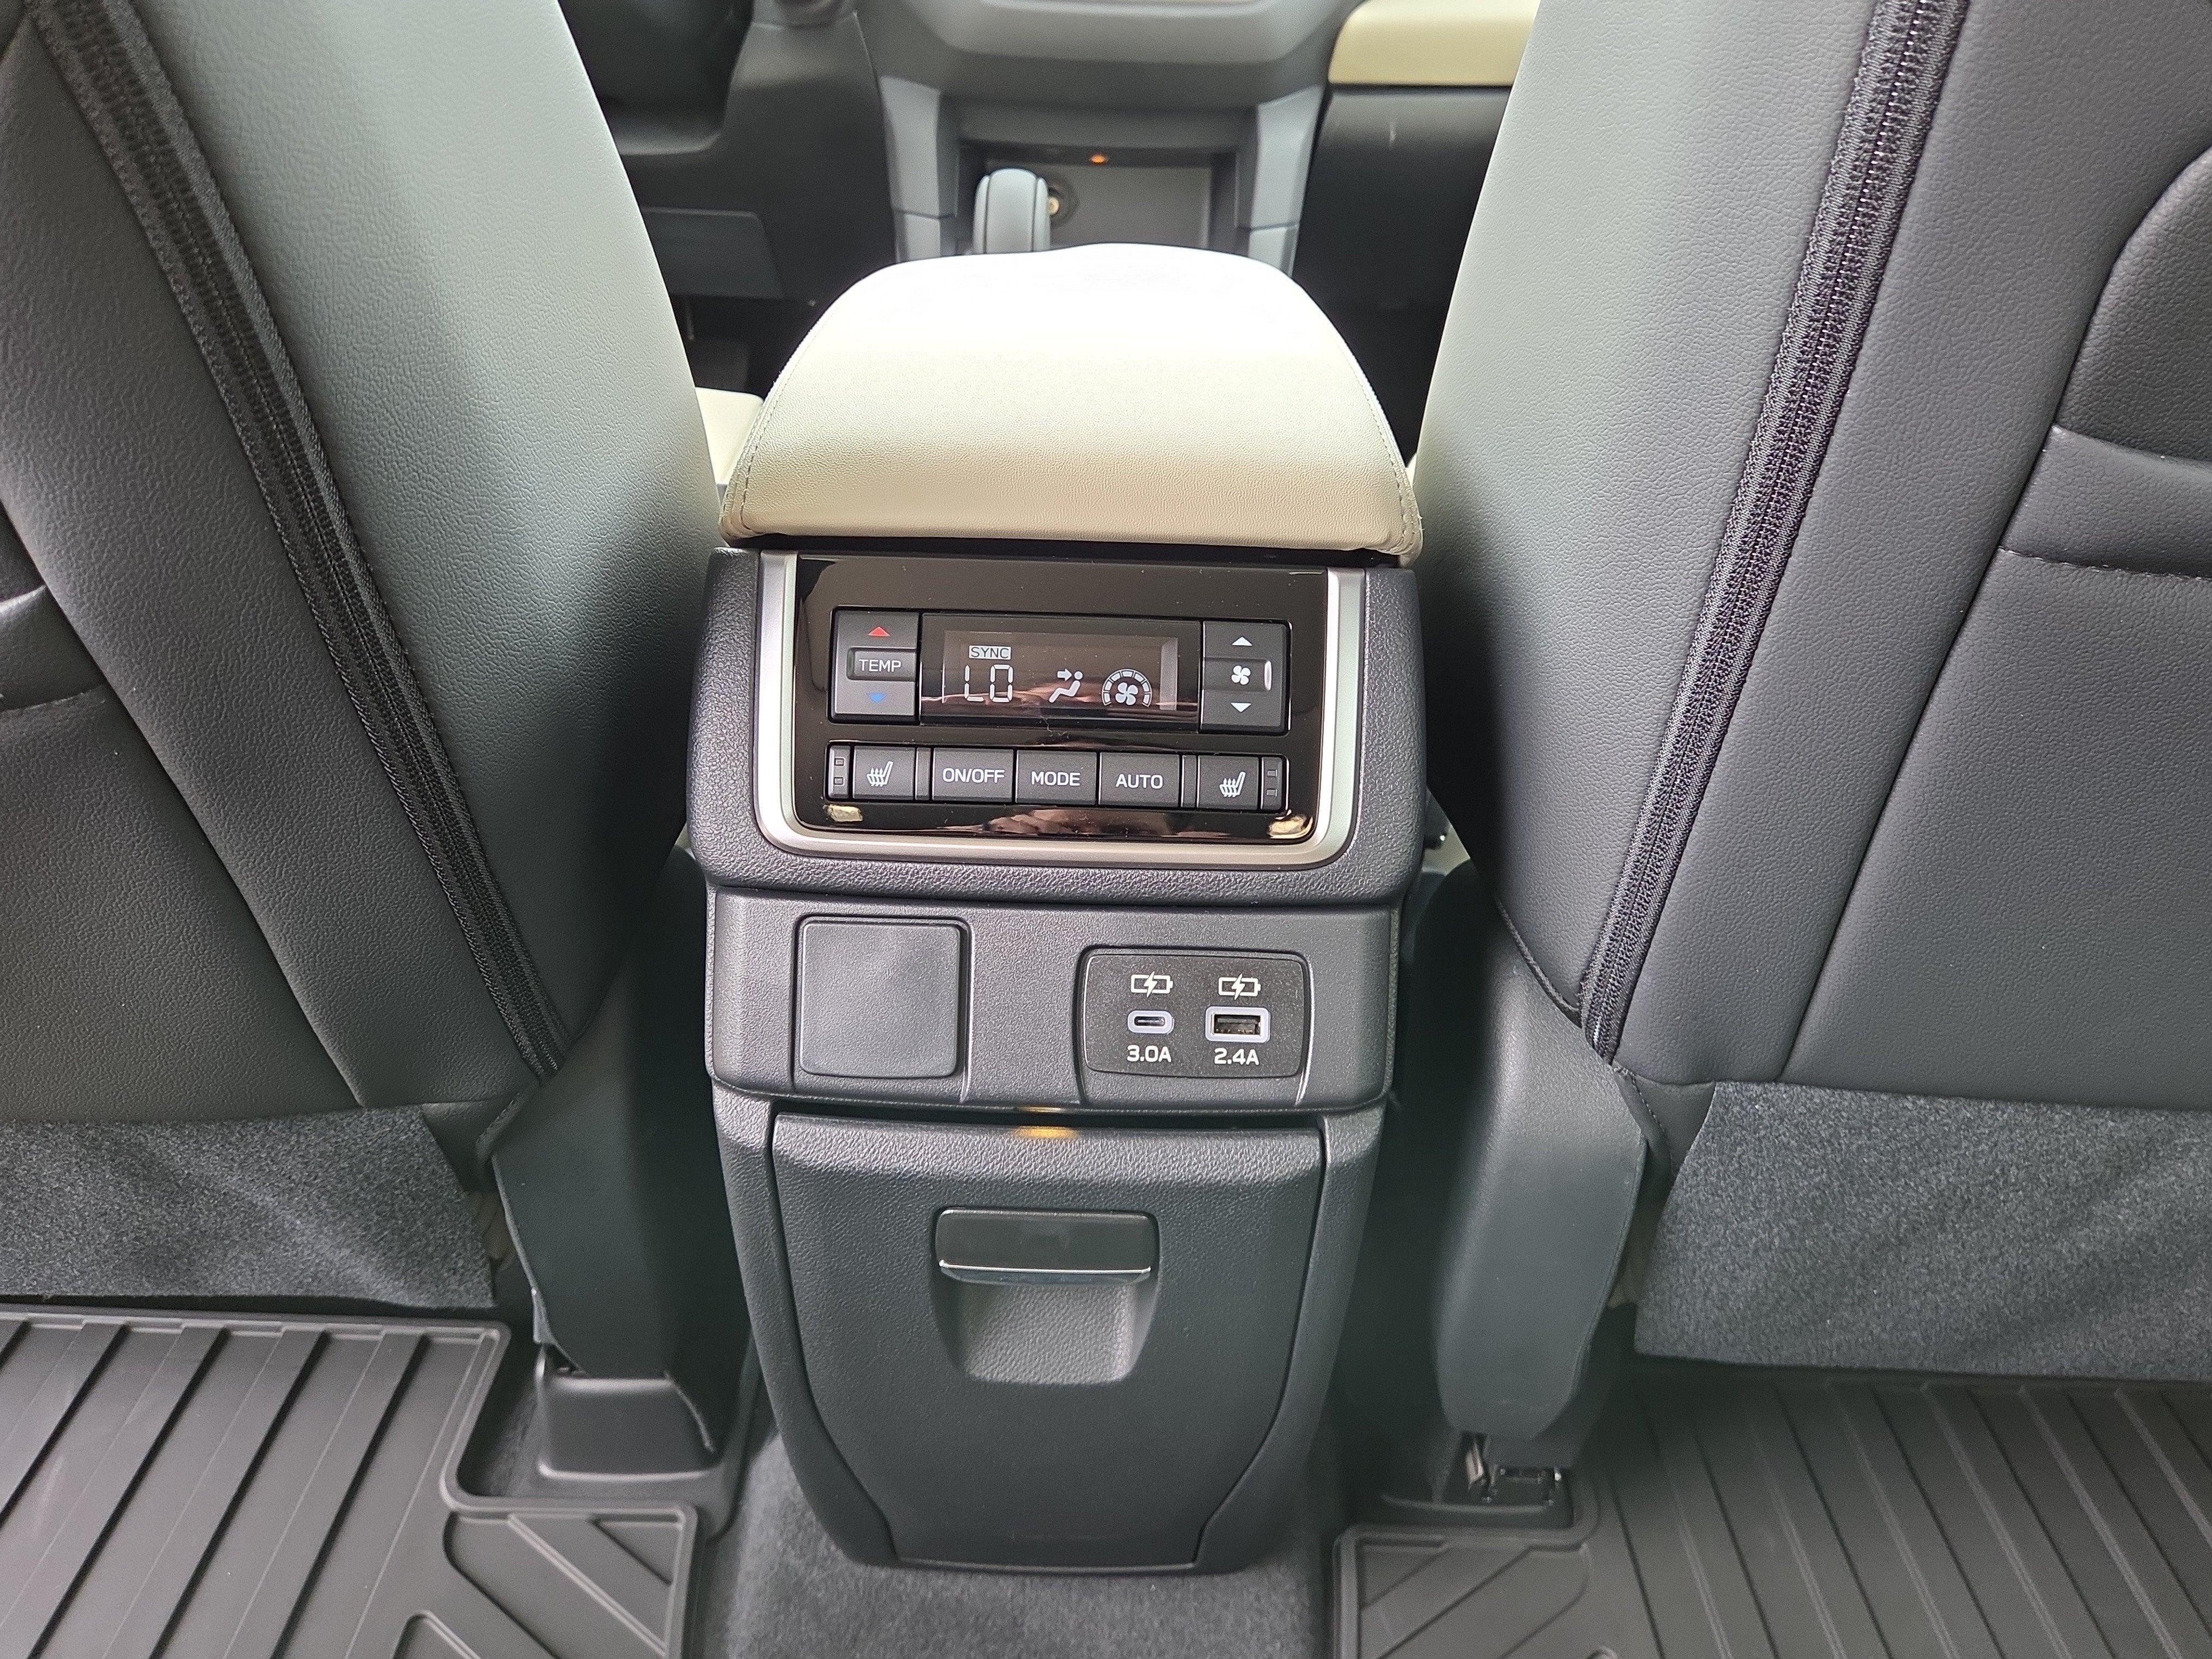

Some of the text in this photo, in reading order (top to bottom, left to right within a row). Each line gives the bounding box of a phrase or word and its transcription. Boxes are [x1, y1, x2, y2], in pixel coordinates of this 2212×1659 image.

[970, 646, 1011, 659] SYNC
[859, 659, 901, 672] TEMP
[942, 768, 1005, 783] ON/OFF
[1031, 772, 1080, 787] MODE
[1116, 775, 1163, 789] AUTO
[1127, 1045, 1172, 1062] 3.0A
[1214, 1049, 1259, 1065] 2.4A
